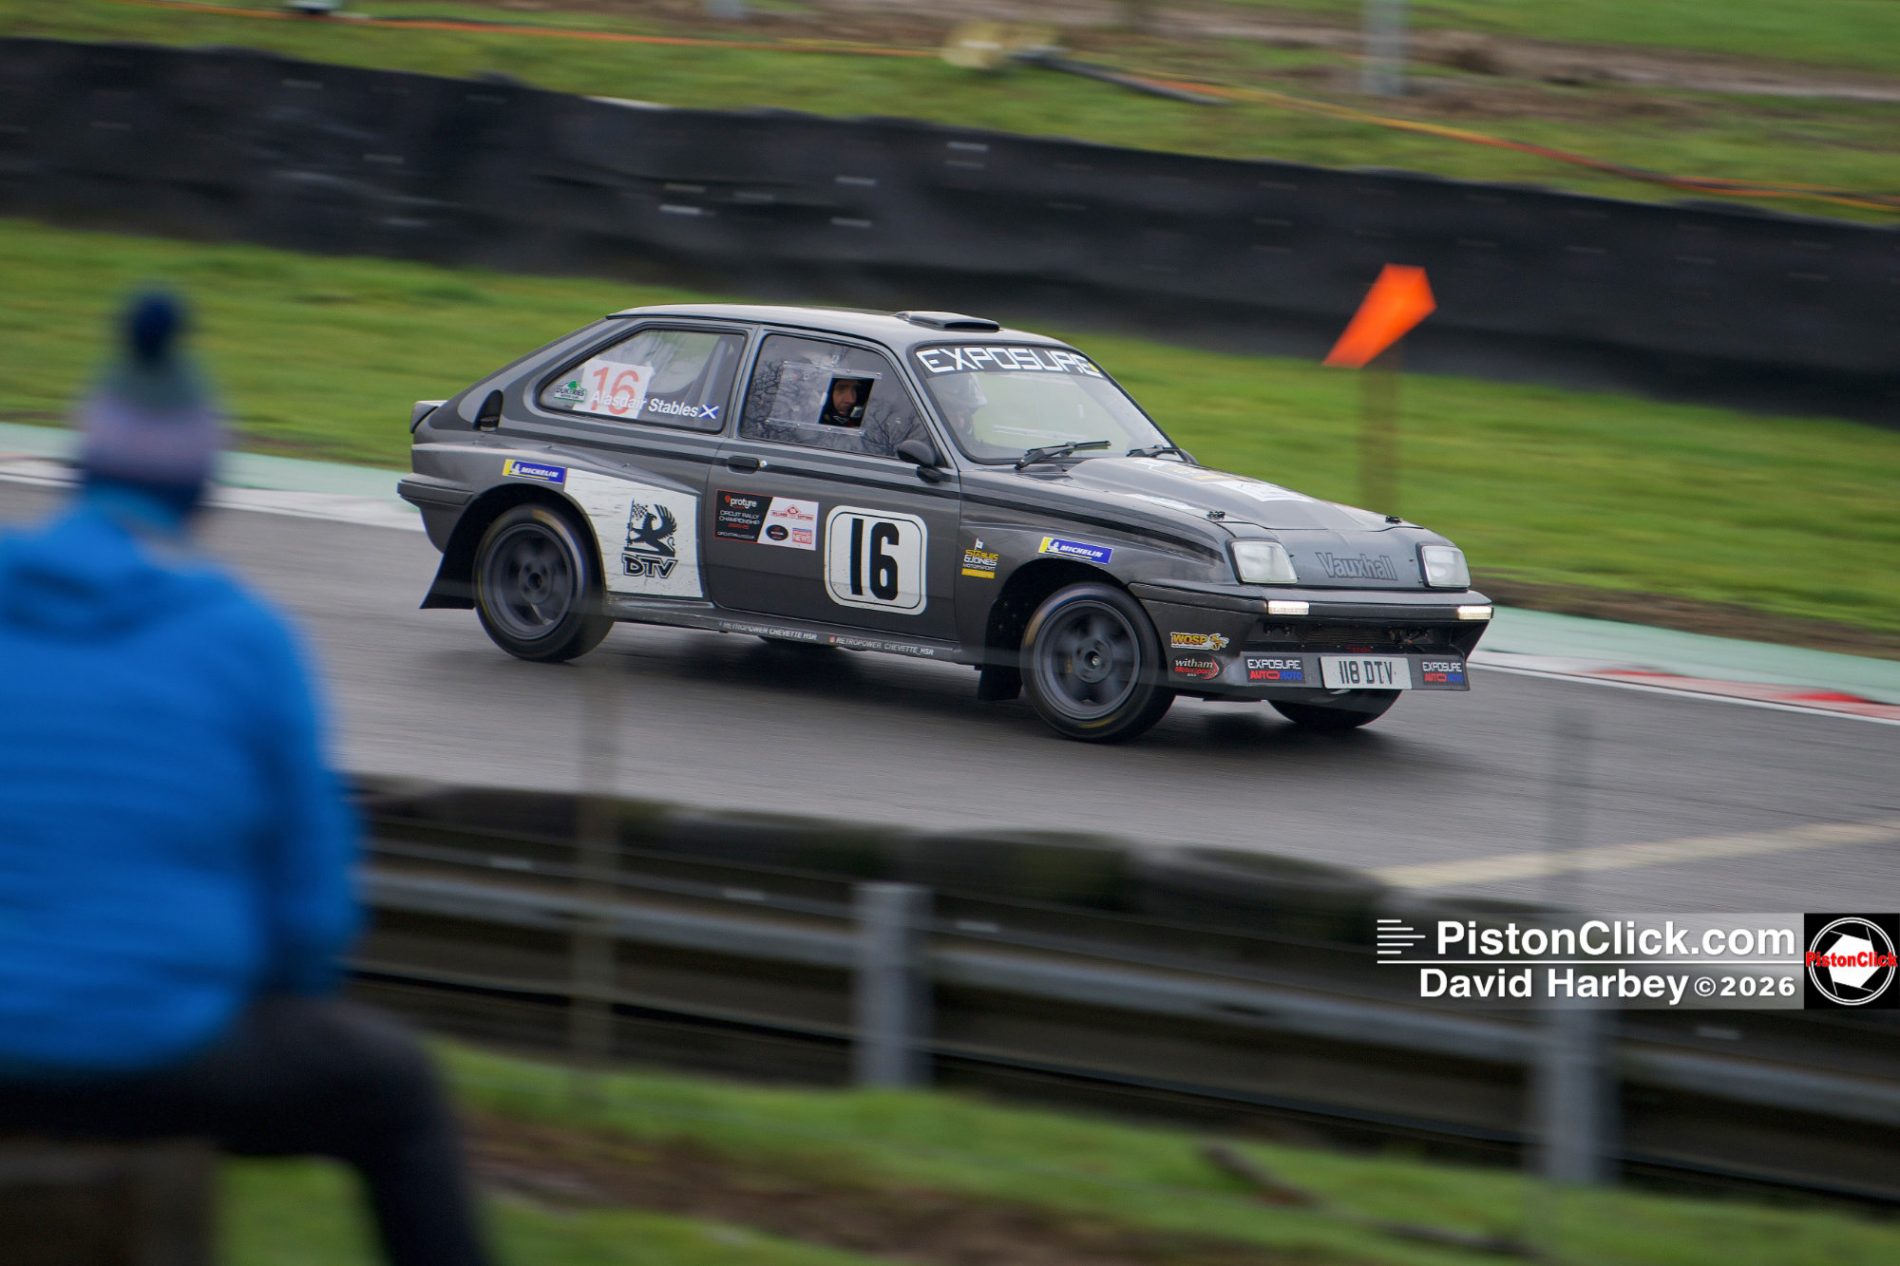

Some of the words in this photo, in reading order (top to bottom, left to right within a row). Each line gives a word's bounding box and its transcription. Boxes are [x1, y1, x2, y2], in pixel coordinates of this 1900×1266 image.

[916, 347, 1104, 378] EXPOSURE
[592, 366, 640, 415] 16
[592, 390, 647, 409] Alasdair
[648, 398, 699, 418] Stables
[521, 467, 559, 478] MICHELIN
[730, 498, 757, 509] protyre
[850, 518, 900, 601] 16
[1060, 545, 1104, 557] MICHELIN
[621, 552, 678, 579] DTV
[1314, 552, 1399, 581] Vauxhall
[1172, 633, 1208, 645] WOSP
[1175, 659, 1213, 668] witham
[1247, 659, 1302, 670] EXPOSURE
[1364, 660, 1393, 685] DTV
[1422, 661, 1463, 672] EXPOSURE
